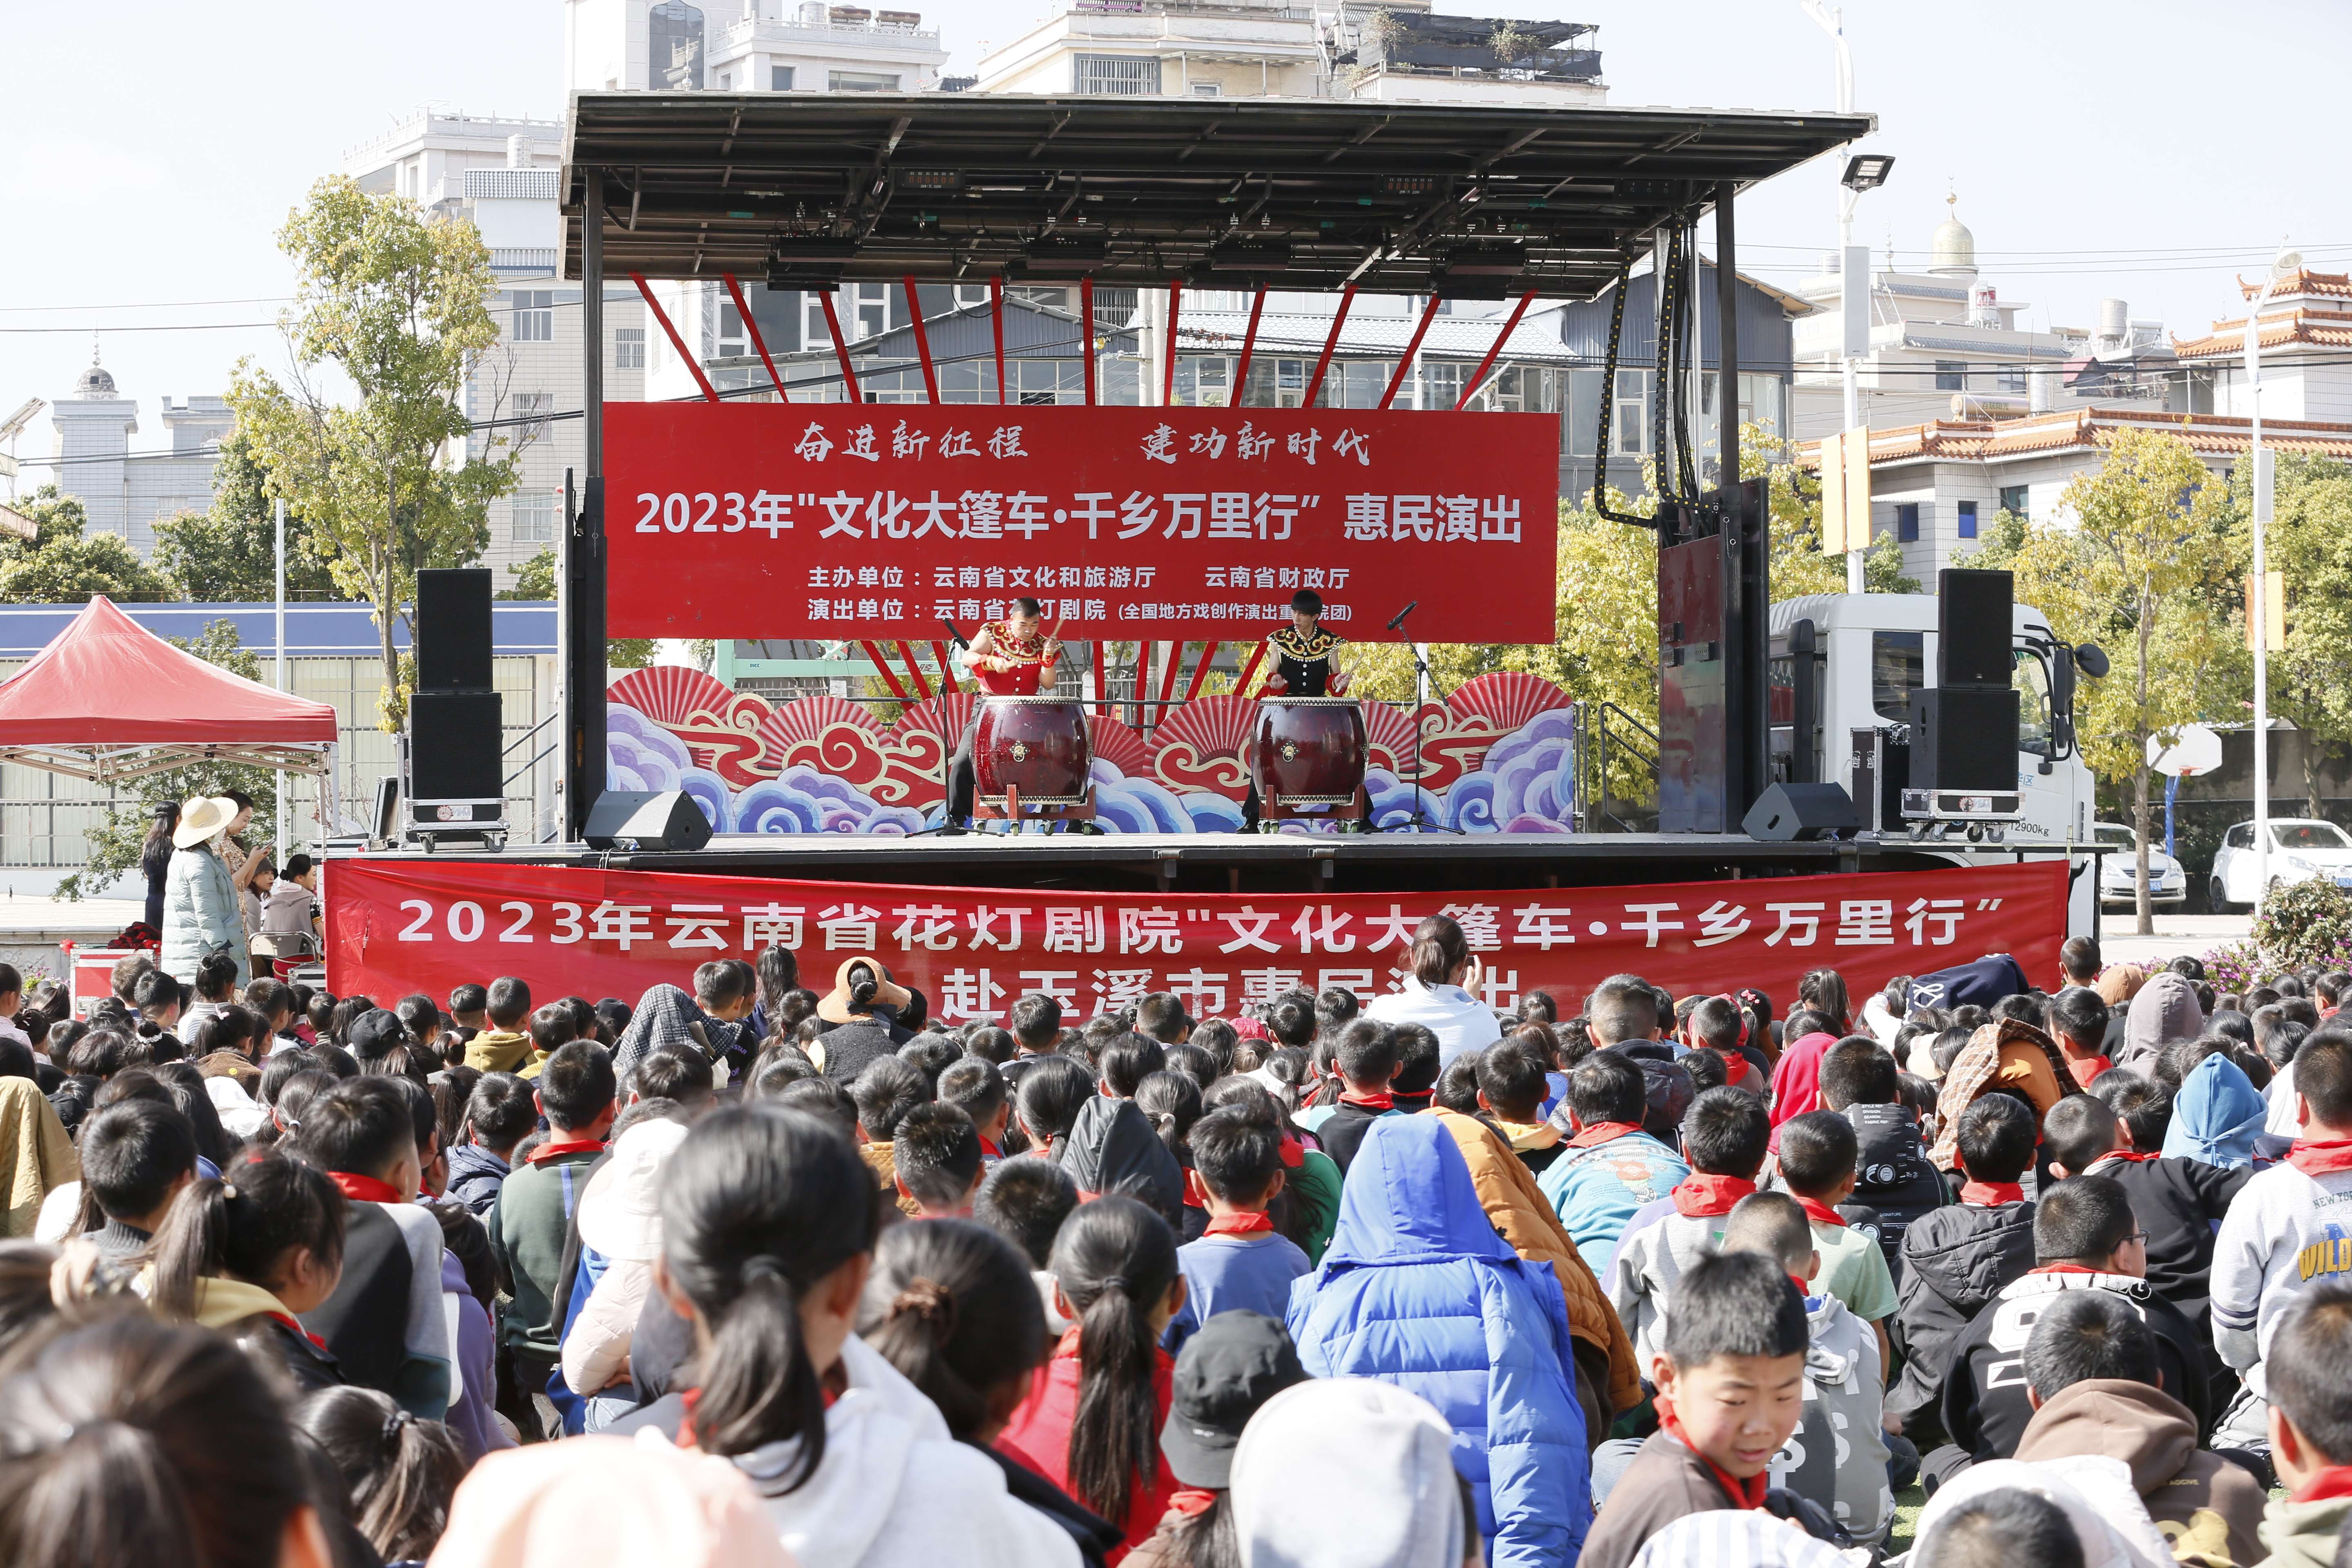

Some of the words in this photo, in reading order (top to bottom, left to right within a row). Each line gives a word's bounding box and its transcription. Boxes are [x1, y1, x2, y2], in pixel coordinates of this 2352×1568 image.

[794, 420, 1028, 462] 奋进新征程
[1140, 421, 1370, 466] 建功新时代
[1344, 492, 1521, 543] 惠民演出
[1205, 566, 1350, 589] 云南省财政厅
[808, 598, 1106, 621] 演出单位：云南省灯剧院
[2313, 1195, 2335, 1209] NEW
